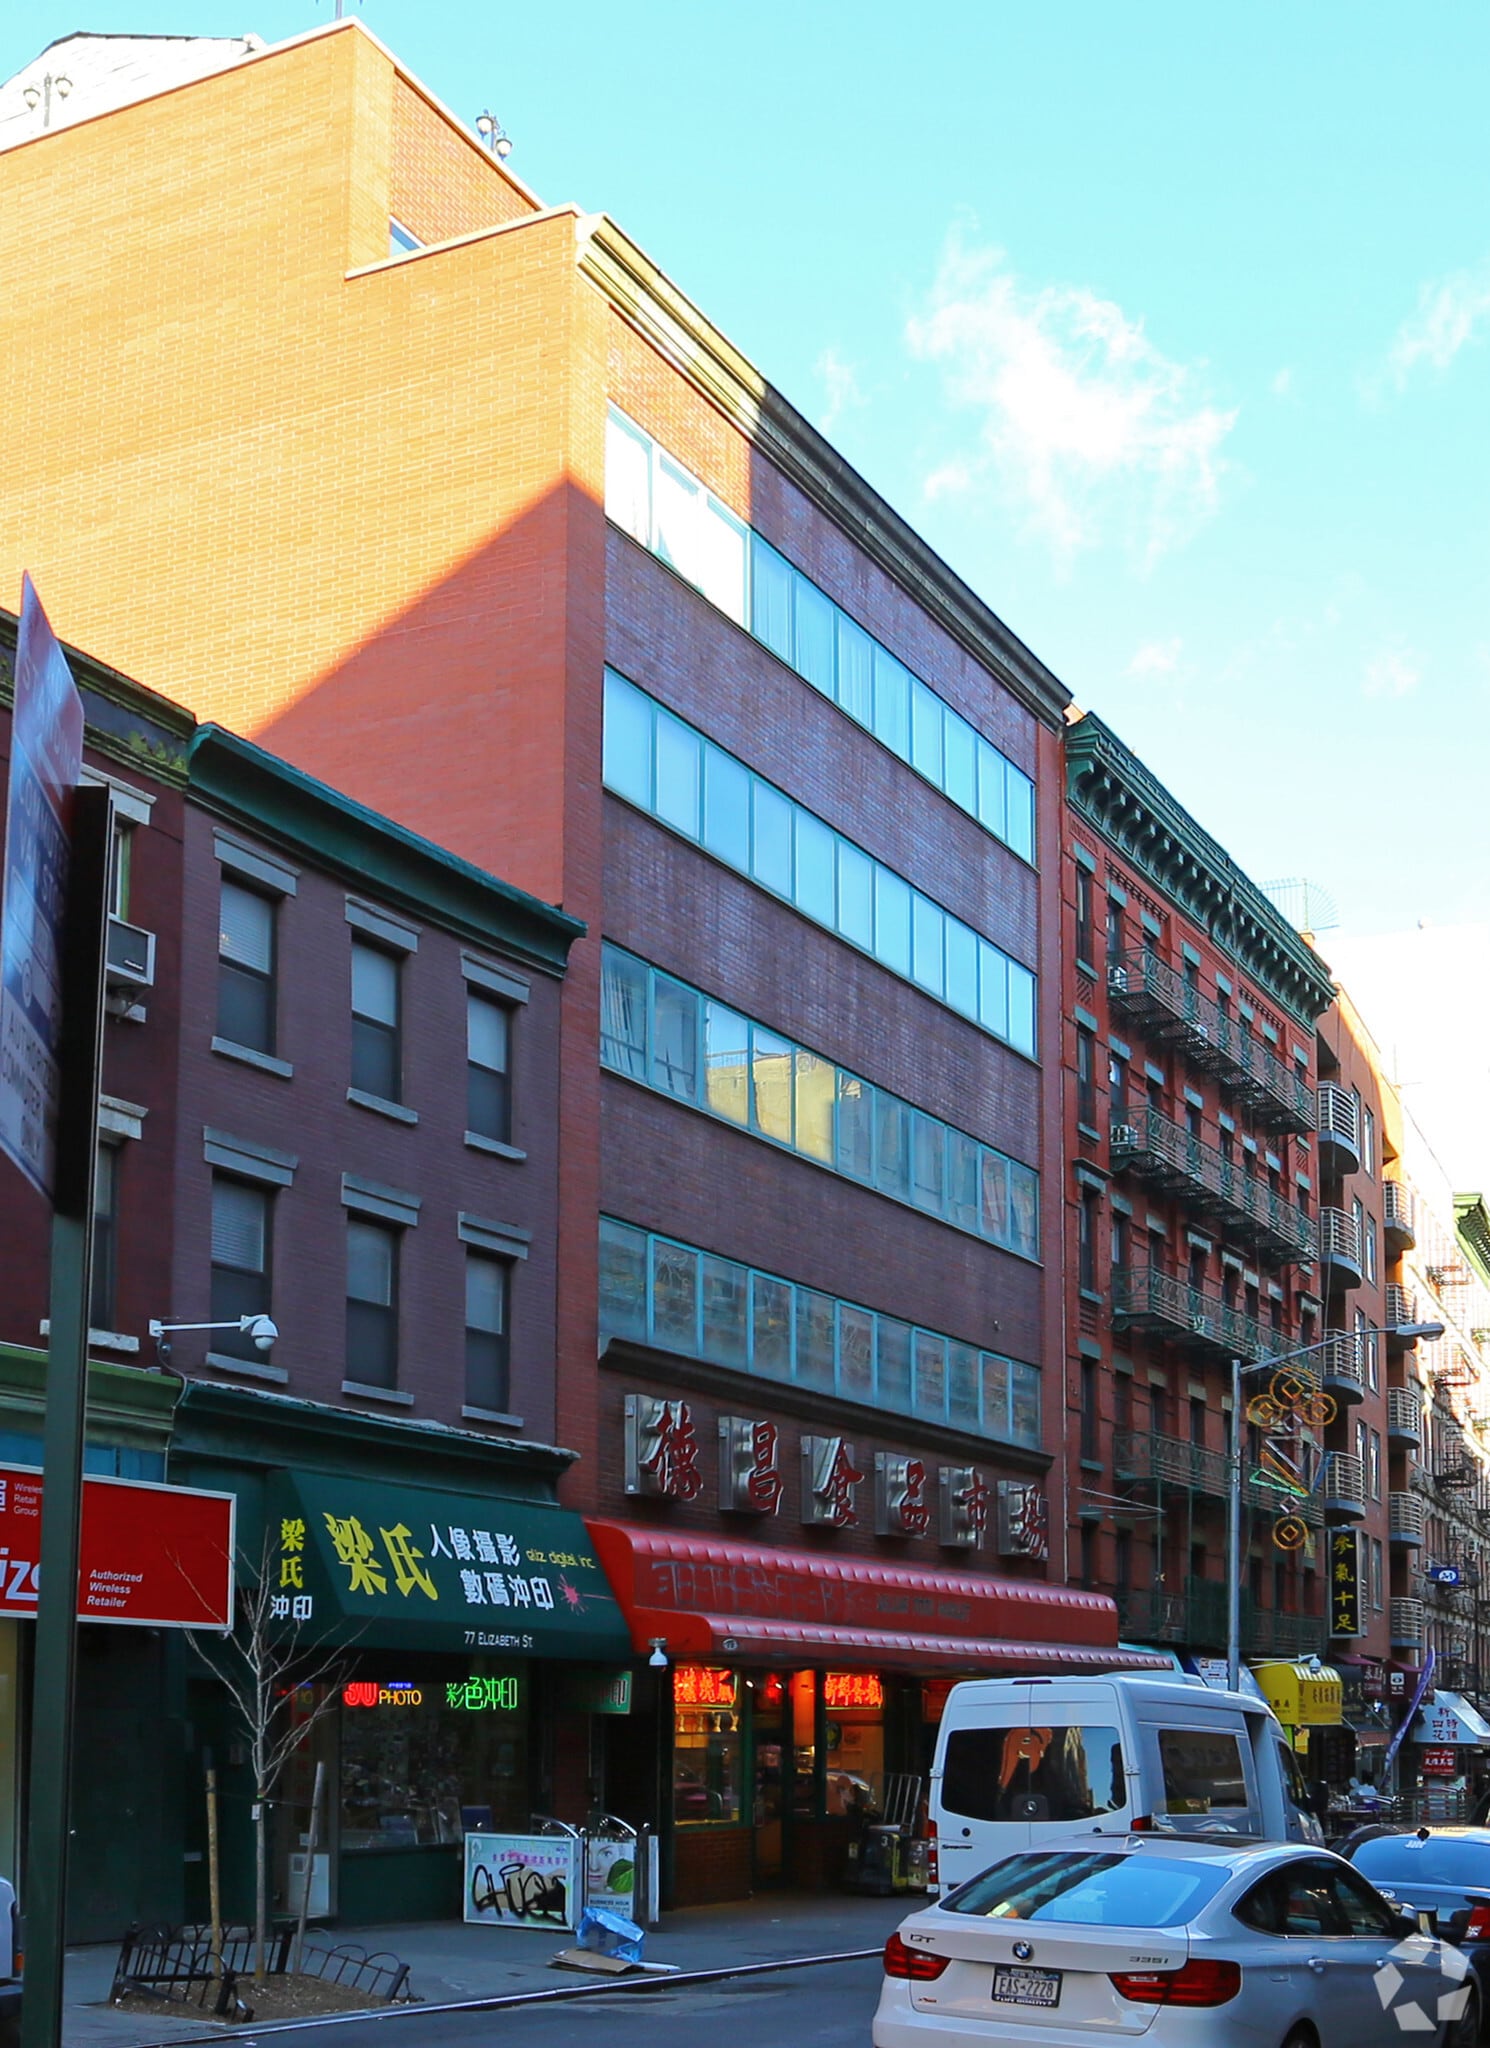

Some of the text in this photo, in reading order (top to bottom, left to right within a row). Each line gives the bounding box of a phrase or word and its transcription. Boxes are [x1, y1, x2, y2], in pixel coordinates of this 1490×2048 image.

[14, 1494, 38, 1505] Retail
[13, 1505, 39, 1517] Group
[429, 1523, 521, 1567] 人像攝影
[280, 1518, 306, 1589] 梁氏
[322, 1512, 439, 1601] 梁氏
[89, 1568, 143, 1583] Authorized
[89, 1582, 131, 1595] Wireless
[86, 1595, 127, 1608] Retailer
[464, 1630, 476, 1645] 77
[379, 1689, 422, 1706] PHOTO
[910, 1933, 936, 1944] GT
